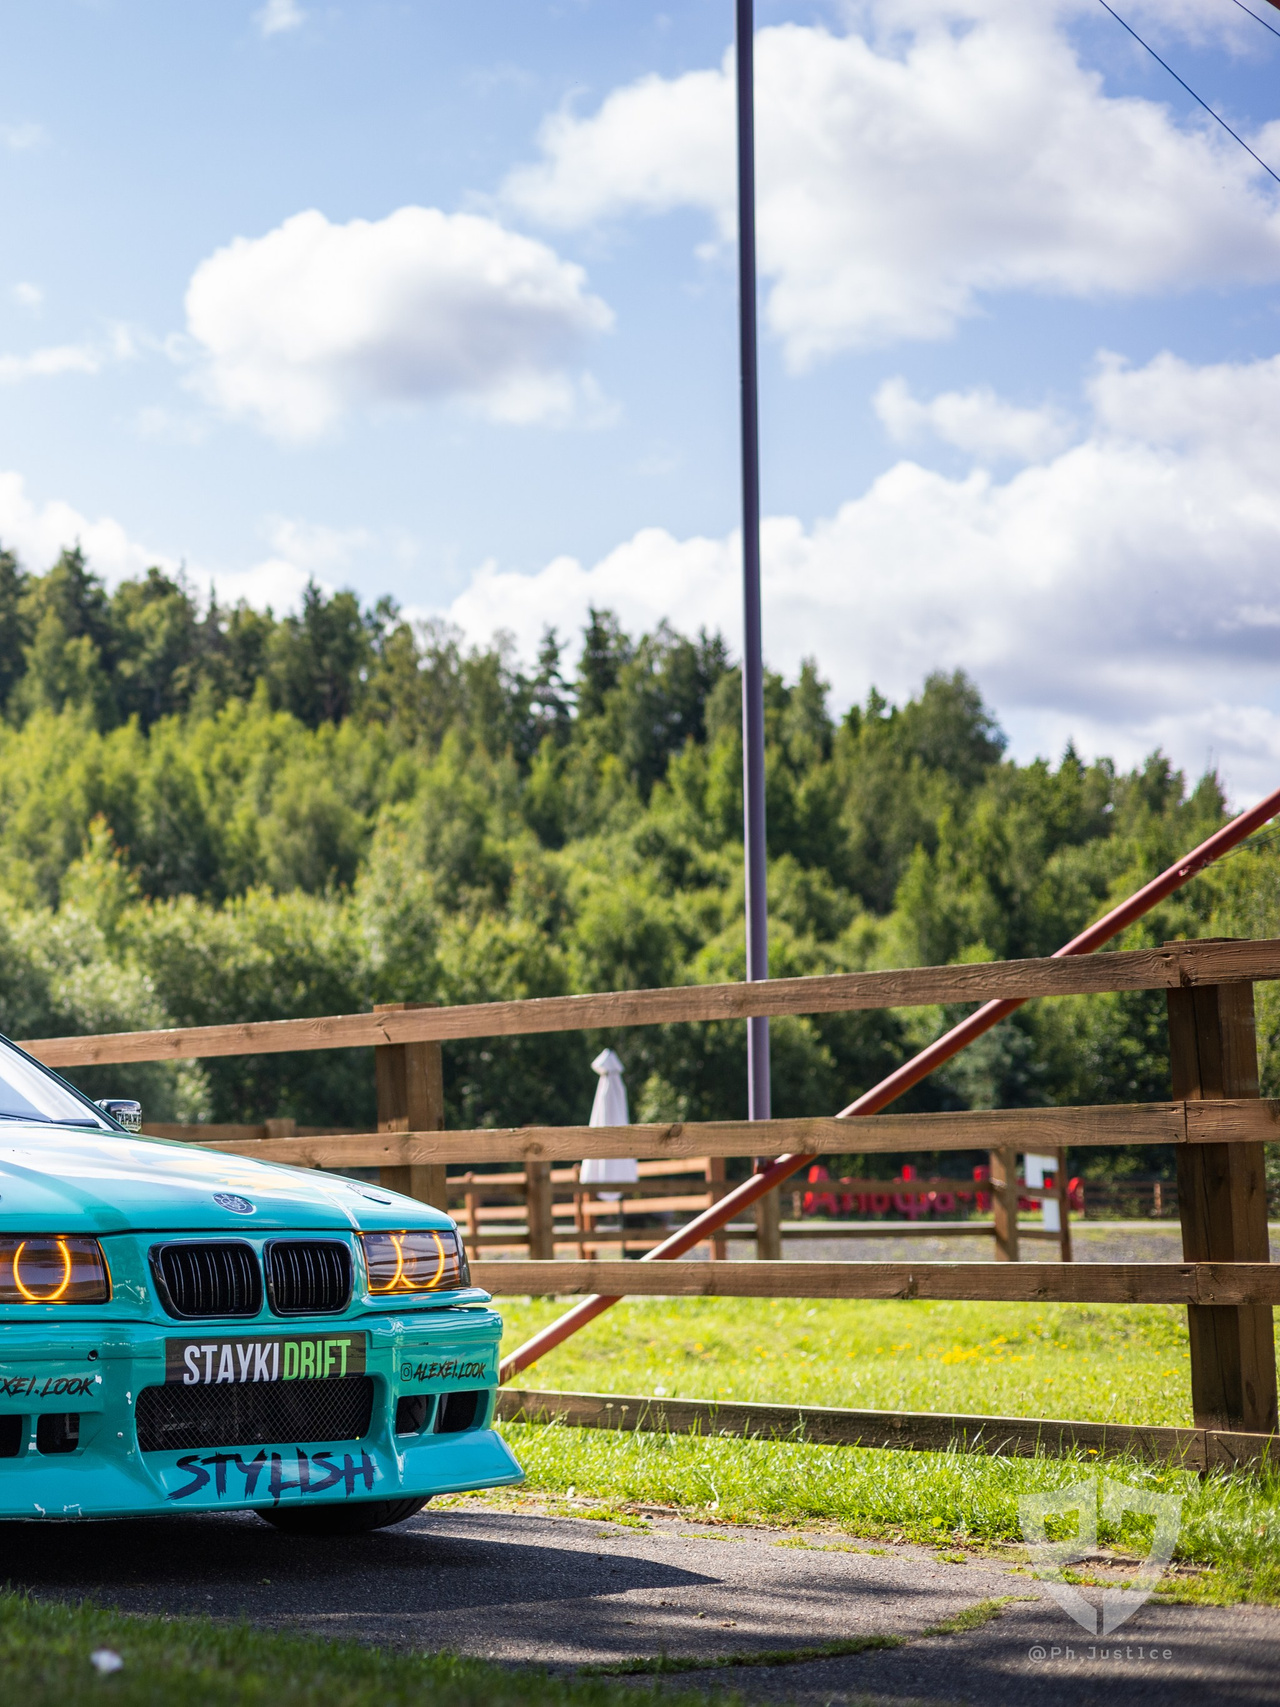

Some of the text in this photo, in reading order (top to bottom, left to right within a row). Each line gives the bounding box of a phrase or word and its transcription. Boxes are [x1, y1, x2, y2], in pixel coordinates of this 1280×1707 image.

[183, 1339, 352, 1386] STAYKI DRIFT
[411, 1360, 486, 1383] ALEXEI.LOOK
[165, 1447, 380, 1507] STYLISH
